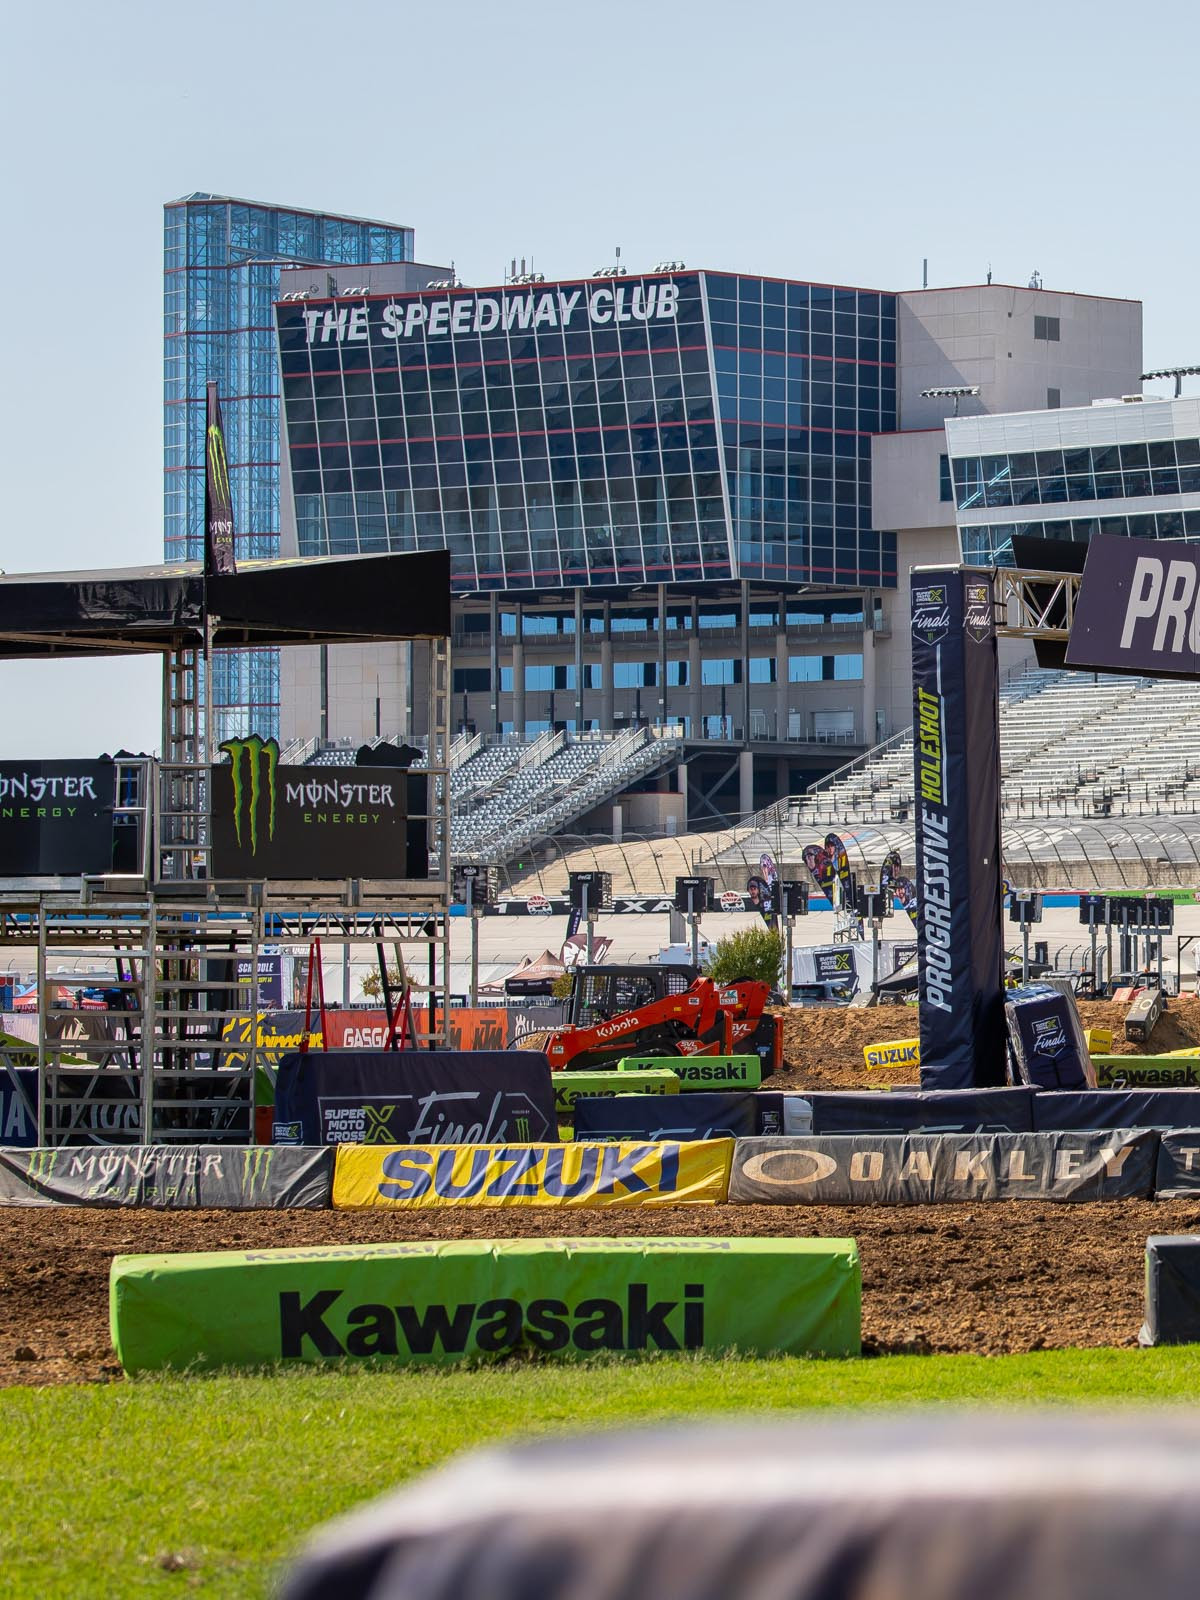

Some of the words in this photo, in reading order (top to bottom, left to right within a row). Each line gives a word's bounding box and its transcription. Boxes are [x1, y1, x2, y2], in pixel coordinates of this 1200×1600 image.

[303, 307, 370, 343] THE
[382, 291, 581, 339] SPEEDWAY
[590, 284, 679, 324] CLUB
[911, 606, 950, 628] Finals
[963, 606, 990, 627] Finals
[919, 687, 941, 804] HOLESHOT
[0, 772, 97, 802] ONSTER
[286, 779, 395, 808] MONSTER
[0, 807, 77, 818] NERGY
[304, 813, 380, 823] ENERGY
[238, 963, 274, 973] SCHDULE
[343, 1026, 402, 1048] GASGA
[473, 1020, 503, 1050] KTM
[597, 1017, 639, 1038] Kubota
[1034, 1031, 1066, 1052] Finals
[325, 1109, 365, 1120] SUPER
[328, 1120, 365, 1131] MOTO
[408, 1091, 507, 1144] Finals
[325, 1131, 366, 1142] CROSS
[70, 1150, 223, 1181] MONSTER
[378, 1144, 679, 1199] SUZUKI
[849, 1146, 1134, 1182] OAKLEY
[279, 1283, 705, 1358] Kawasaki
